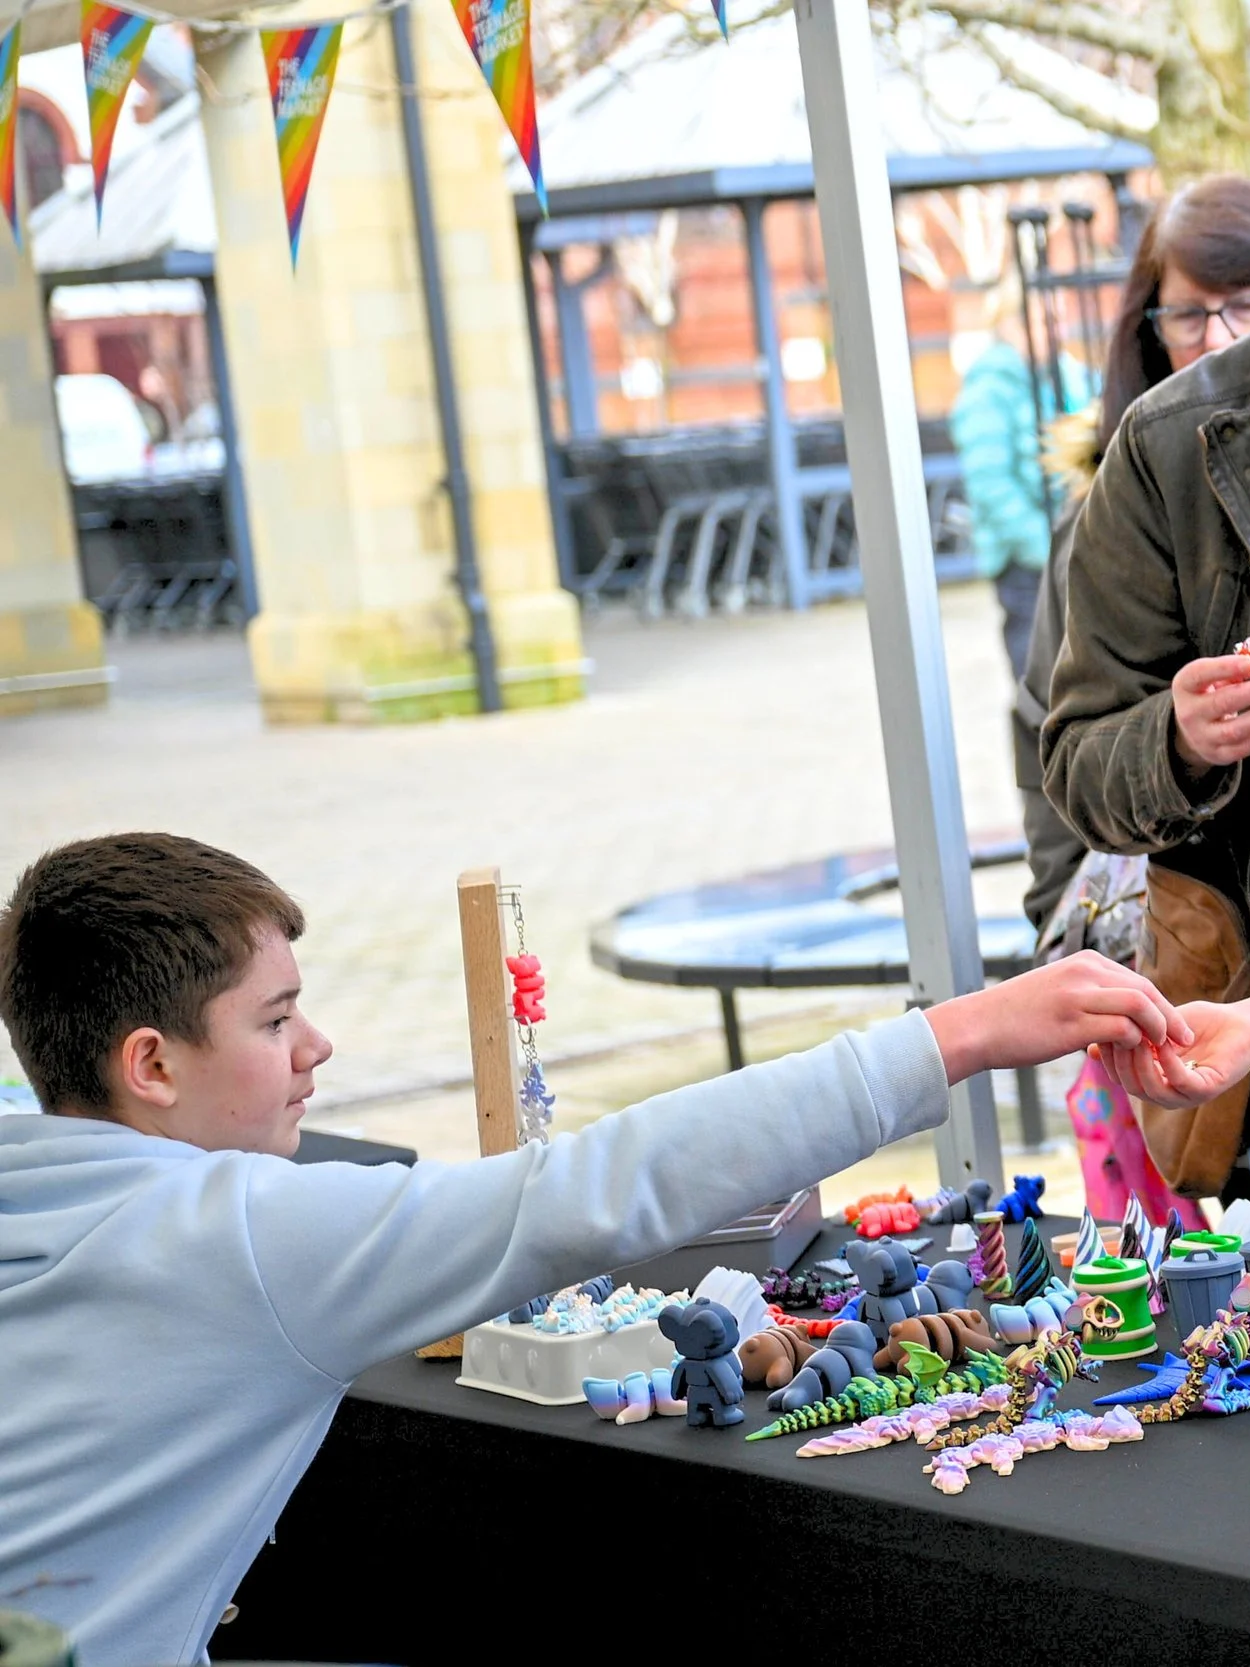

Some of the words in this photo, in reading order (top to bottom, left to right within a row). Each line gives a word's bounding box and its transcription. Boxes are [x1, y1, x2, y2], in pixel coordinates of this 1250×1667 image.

[468, 0, 490, 24] THE
[472, 0, 526, 46] TEENAGE
[90, 27, 110, 48] THE
[479, 21, 525, 63] MARKET
[277, 57, 300, 79] THE
[277, 73, 329, 101] TEENAGE
[276, 96, 324, 119] MARKET
